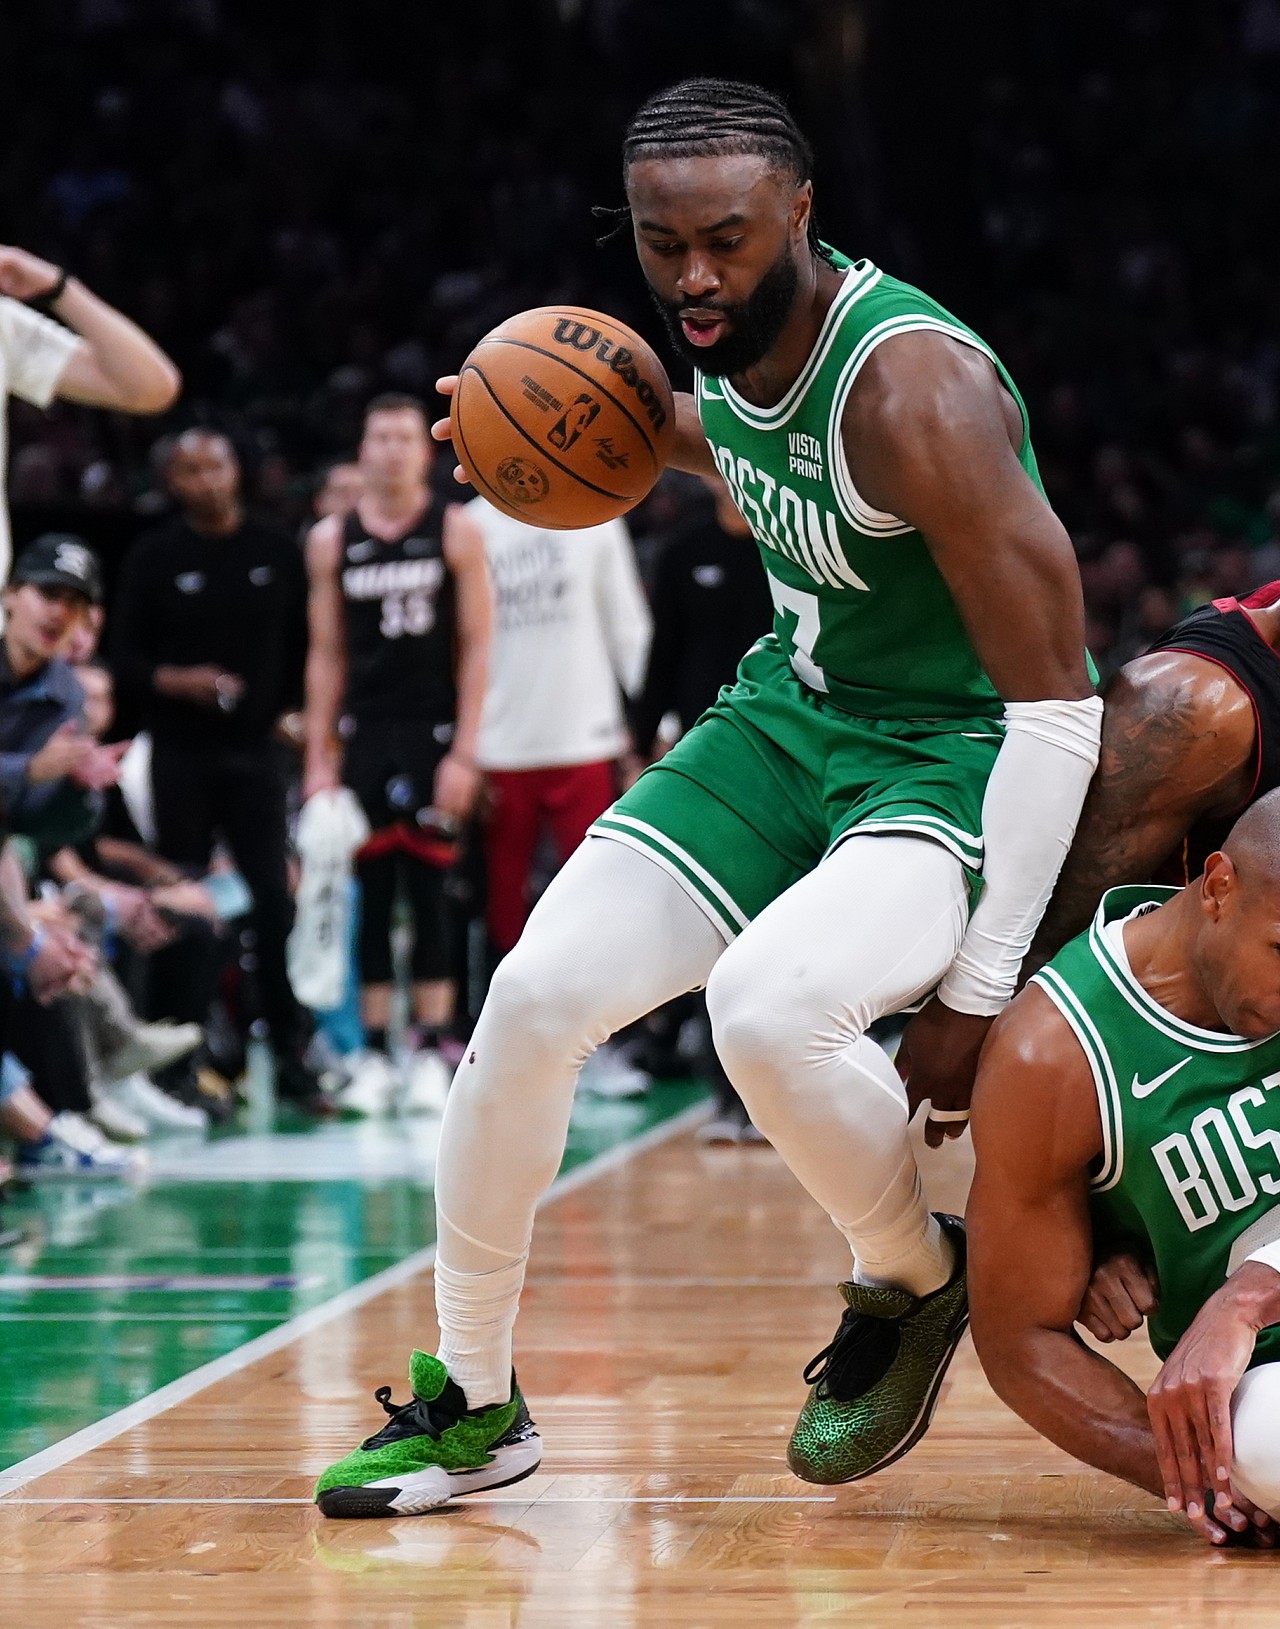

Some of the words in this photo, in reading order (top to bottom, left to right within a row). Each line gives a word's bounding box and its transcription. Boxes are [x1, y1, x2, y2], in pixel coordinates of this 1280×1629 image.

[552, 318, 666, 433] Wilson
[788, 432, 823, 465] VISTA
[788, 455, 824, 482] PRINT
[705, 436, 871, 592] OSTON
[766, 567, 829, 693] 7
